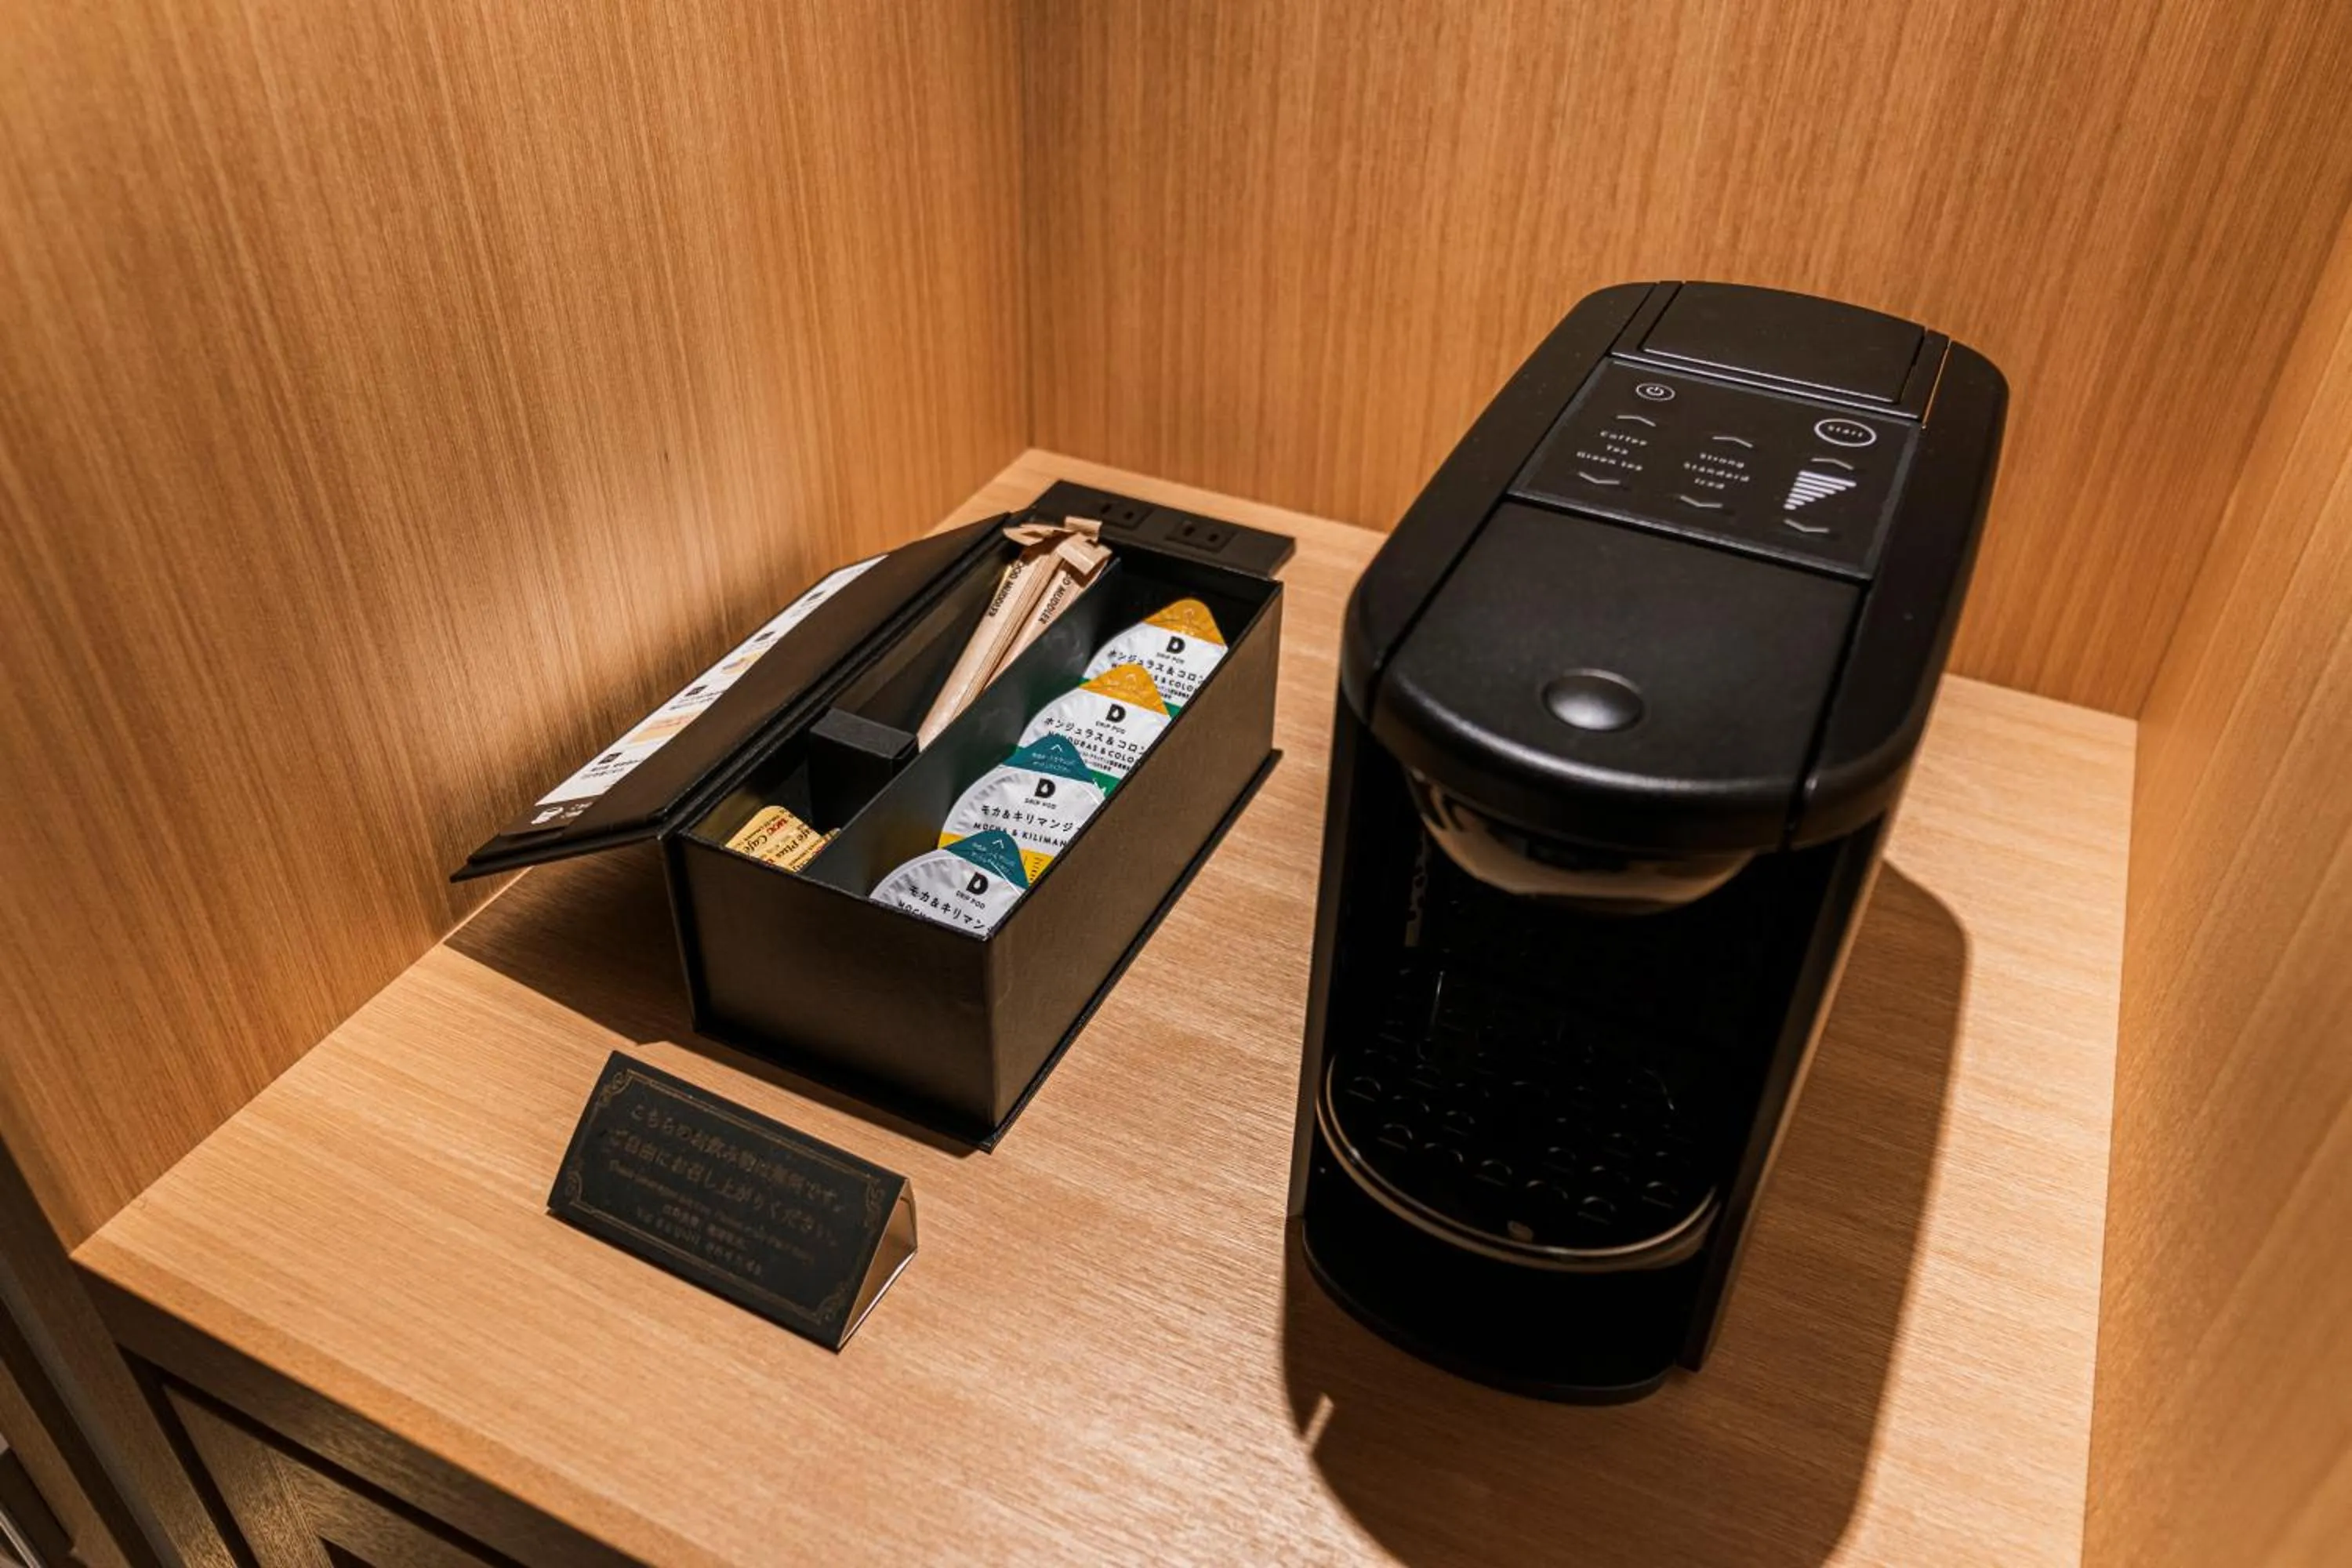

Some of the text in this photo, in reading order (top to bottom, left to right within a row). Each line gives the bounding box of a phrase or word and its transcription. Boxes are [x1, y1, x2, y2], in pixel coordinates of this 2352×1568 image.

[1108, 746, 1135, 764] COLO
[981, 805, 1080, 833] モカ&キリマンジ
[908, 884, 992, 933] モカ&キリマン
